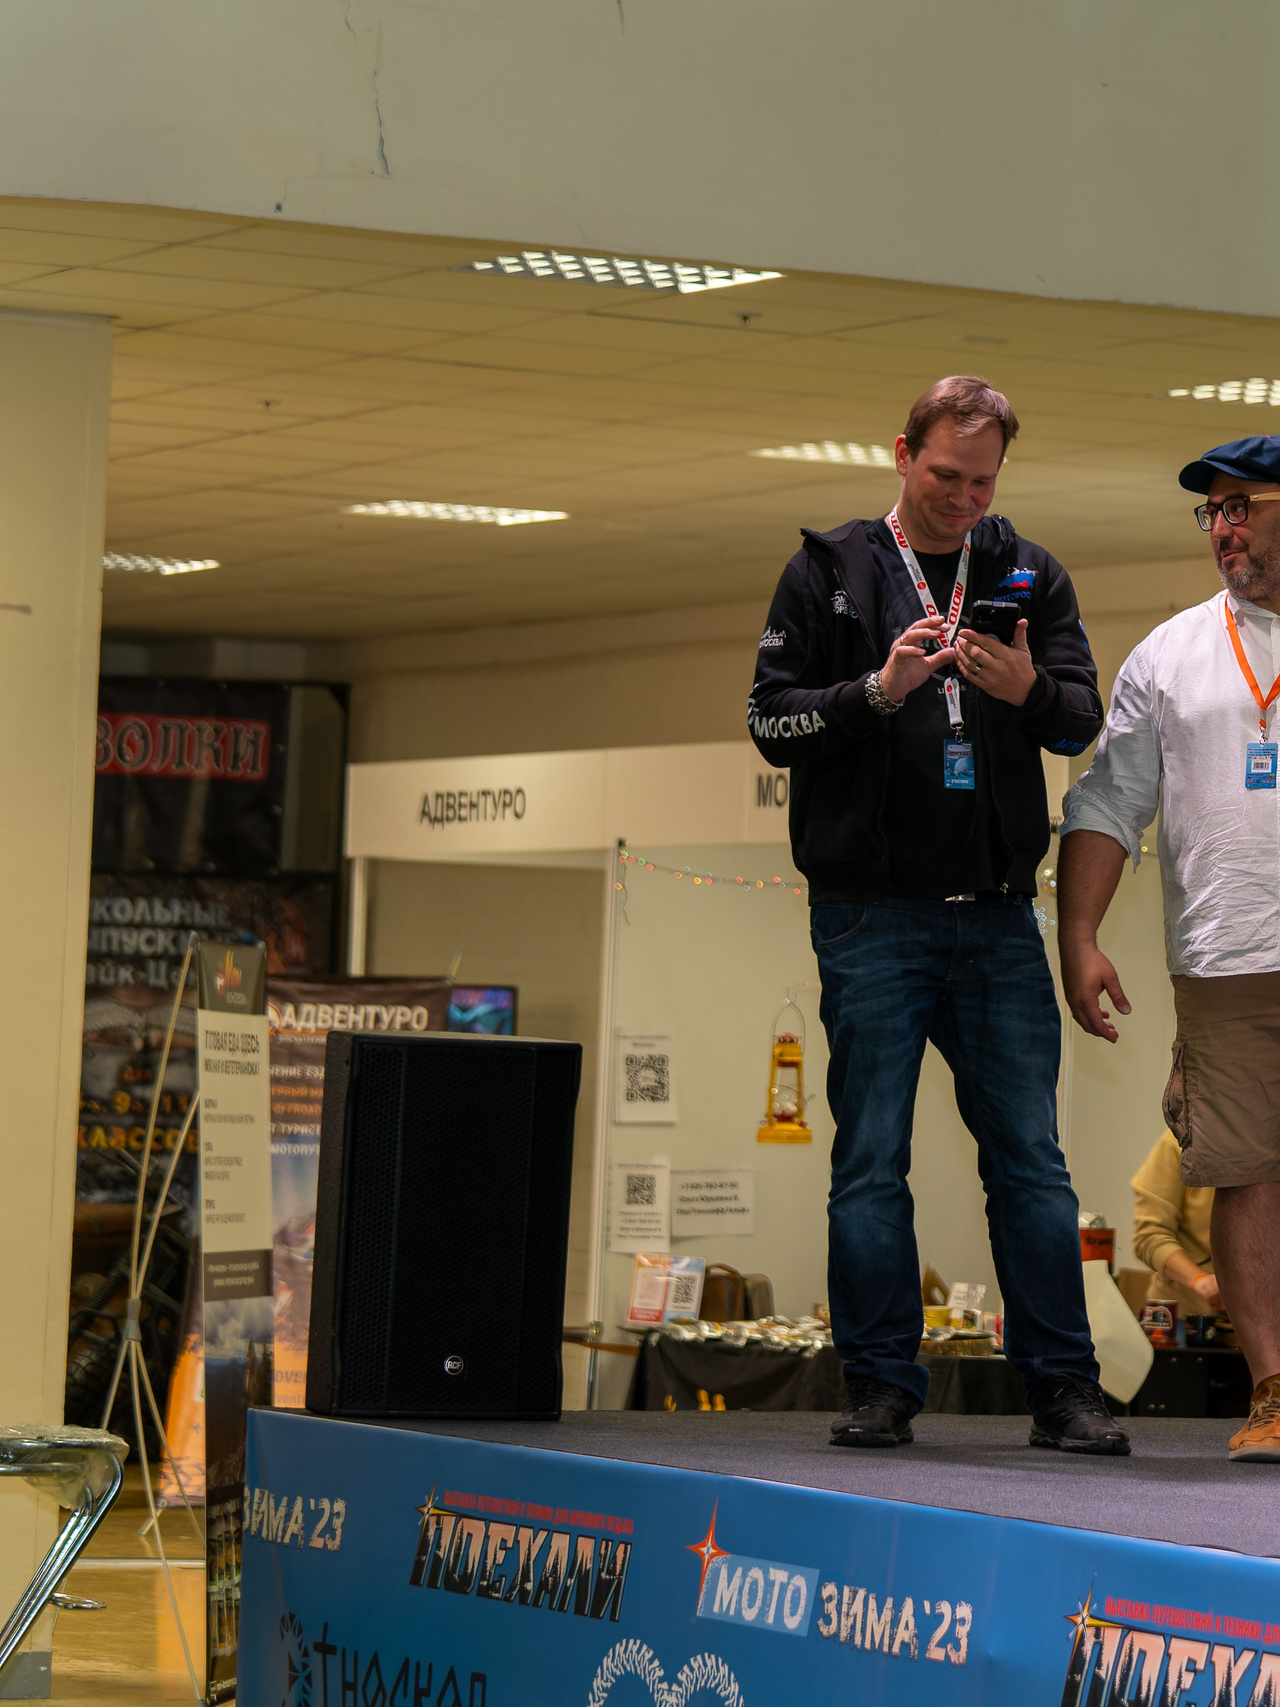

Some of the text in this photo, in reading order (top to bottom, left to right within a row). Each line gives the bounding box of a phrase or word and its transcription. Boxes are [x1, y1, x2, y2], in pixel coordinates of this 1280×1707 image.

[754, 710, 826, 739] МОСКВА
[419, 786, 527, 830] АДВЕНТУРО
[282, 1002, 429, 1033] АДВЕНТУРО
[409, 1514, 633, 1623] ПОЕХАЛИ
[713, 1563, 808, 1630] МОТО
[1105, 1596, 1150, 1621] ВЫСТАВКА
[1152, 1604, 1214, 1632] ПУТЕШЕСТВИЙ
[1215, 1615, 1222, 1633] И
[1224, 1616, 1263, 1638] ТЕХНИКИ
